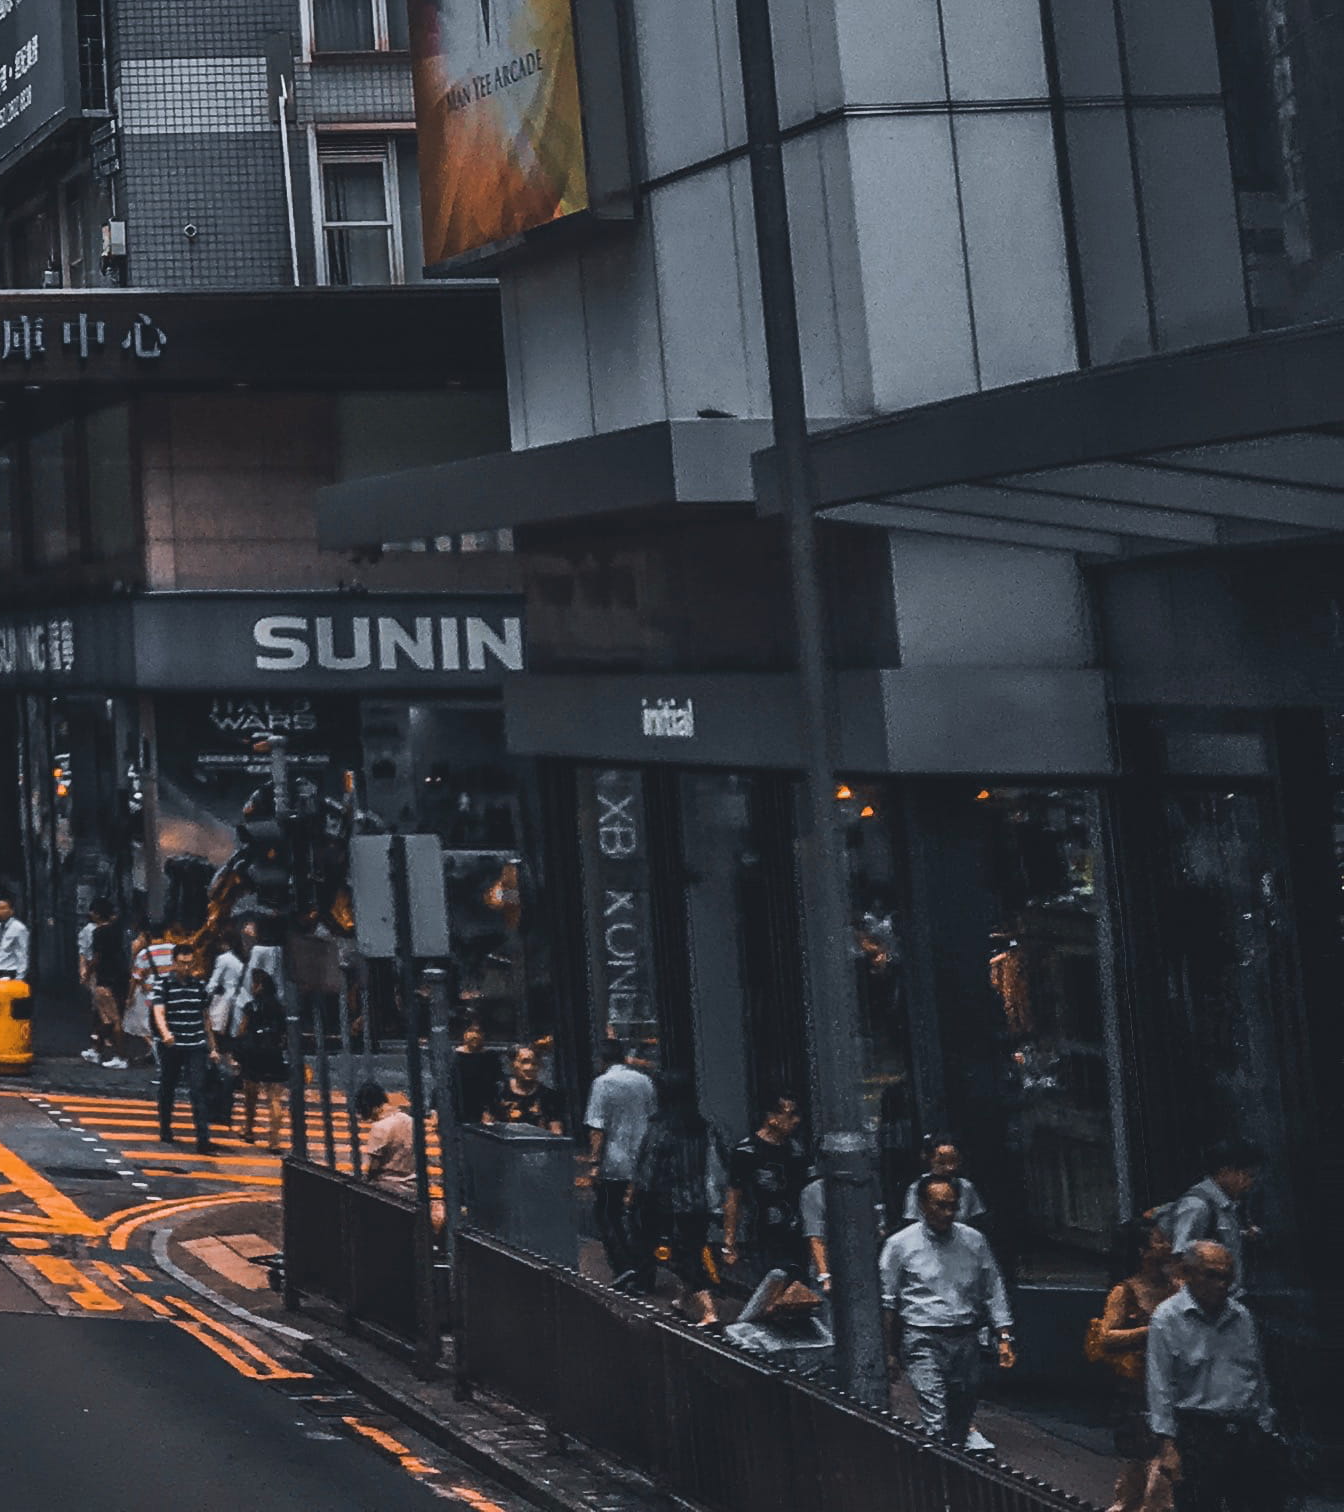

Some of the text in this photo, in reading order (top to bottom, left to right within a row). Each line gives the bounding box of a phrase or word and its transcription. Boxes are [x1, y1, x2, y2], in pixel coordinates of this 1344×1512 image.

[446, 48, 543, 111] MAN YEE ARCADE
[209, 714, 317, 730] WARS
